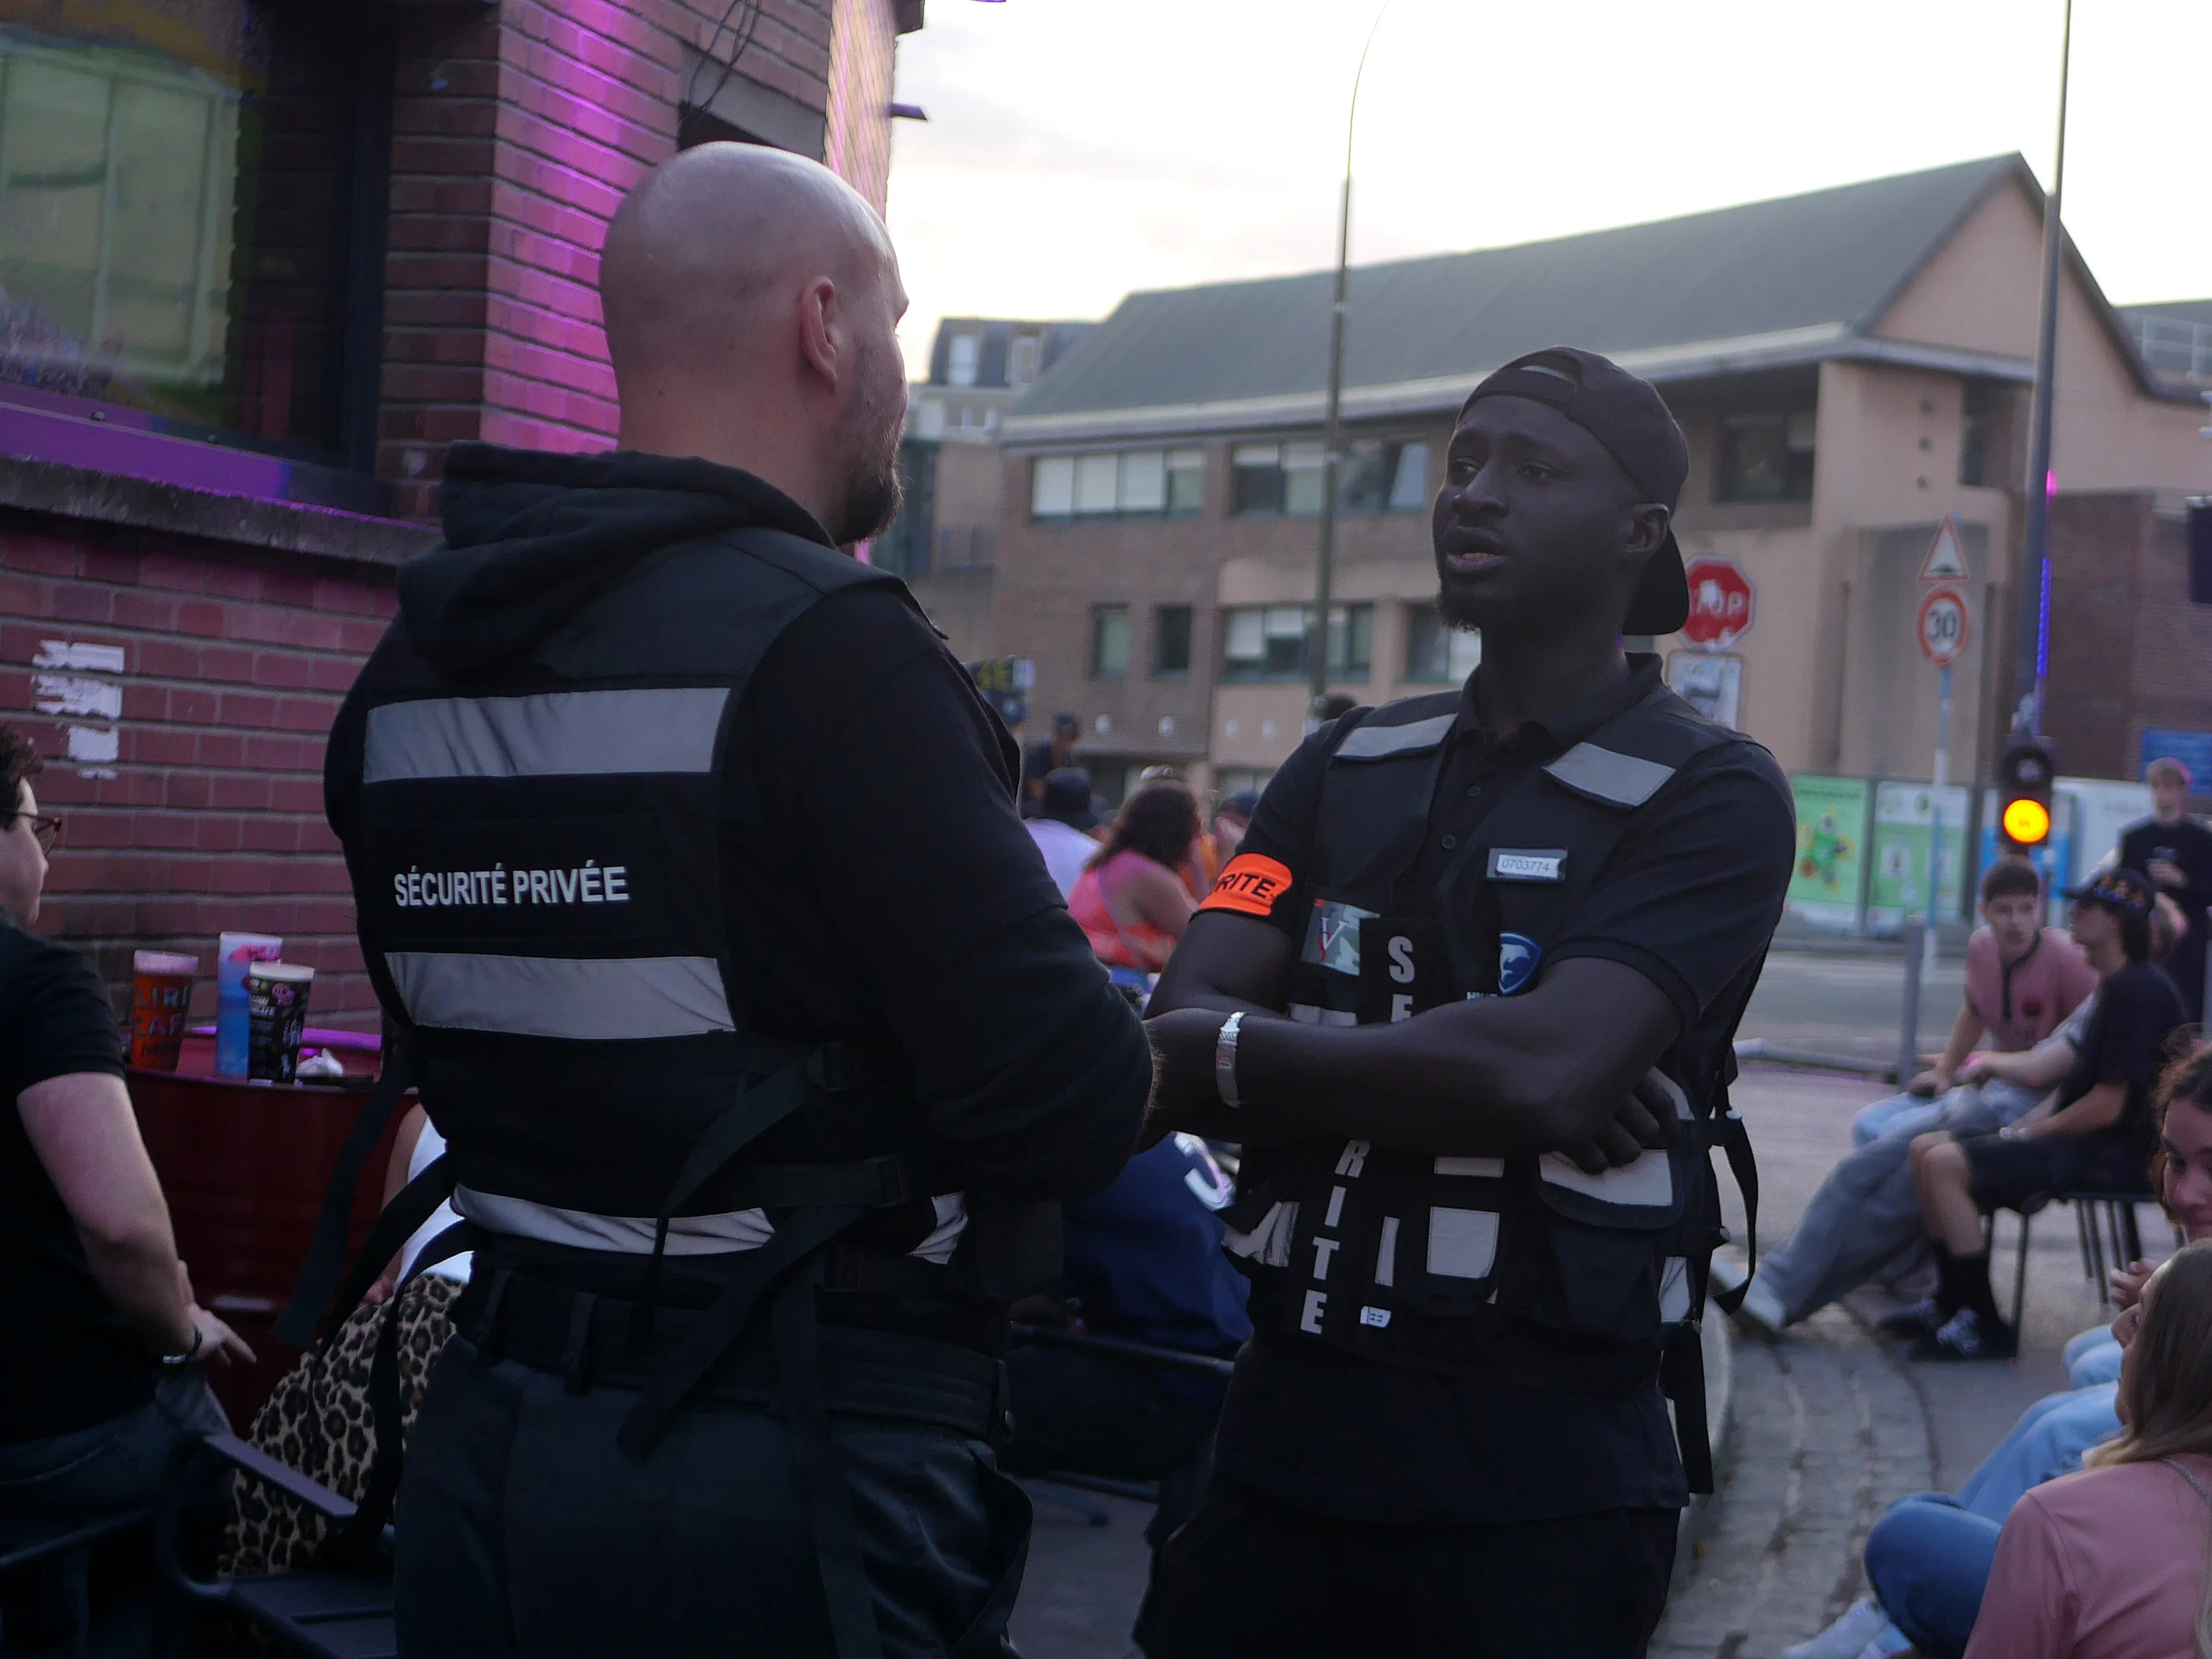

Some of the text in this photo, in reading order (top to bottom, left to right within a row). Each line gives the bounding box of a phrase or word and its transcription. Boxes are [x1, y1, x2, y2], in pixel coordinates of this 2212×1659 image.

[1927, 609, 1958, 640] 30
[1502, 857, 1550, 871] 0703774
[394, 859, 630, 907] SÉCURITÉ PRIVÉE
